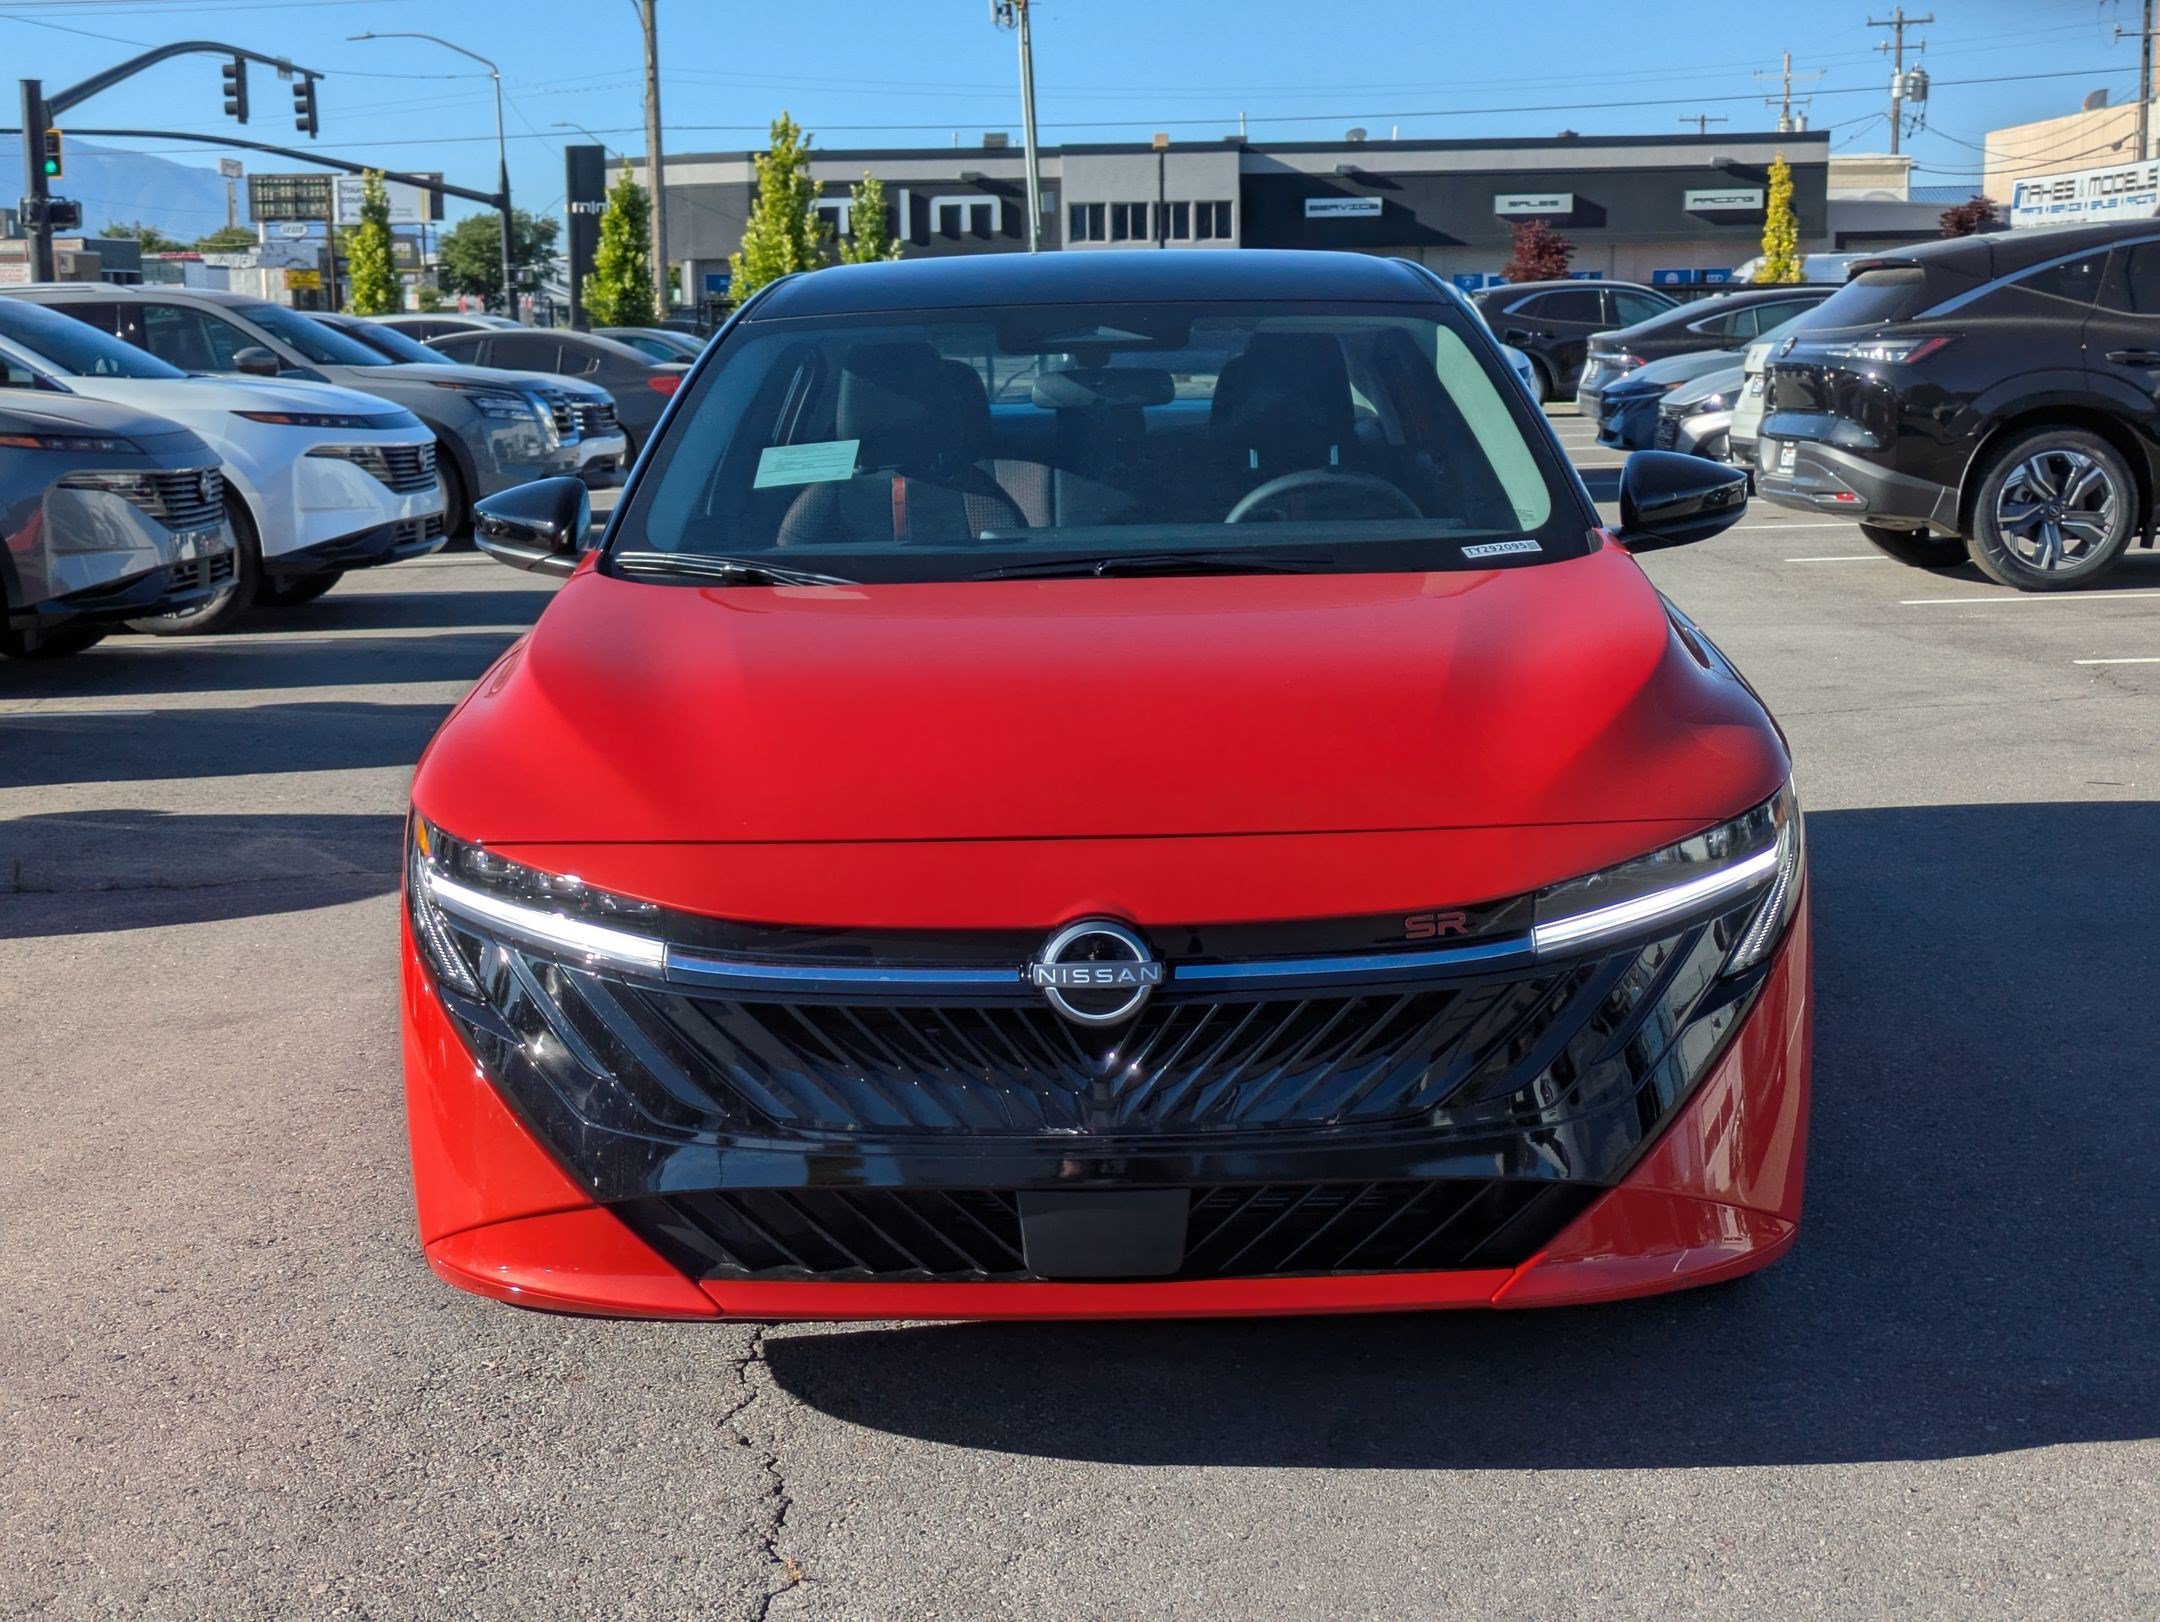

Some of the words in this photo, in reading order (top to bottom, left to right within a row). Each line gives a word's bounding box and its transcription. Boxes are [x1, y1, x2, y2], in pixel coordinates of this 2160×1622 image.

[1308, 203, 1380, 211] SERVICE
[1405, 912, 1468, 939] SR
[1039, 966, 1158, 983] NISSAN
